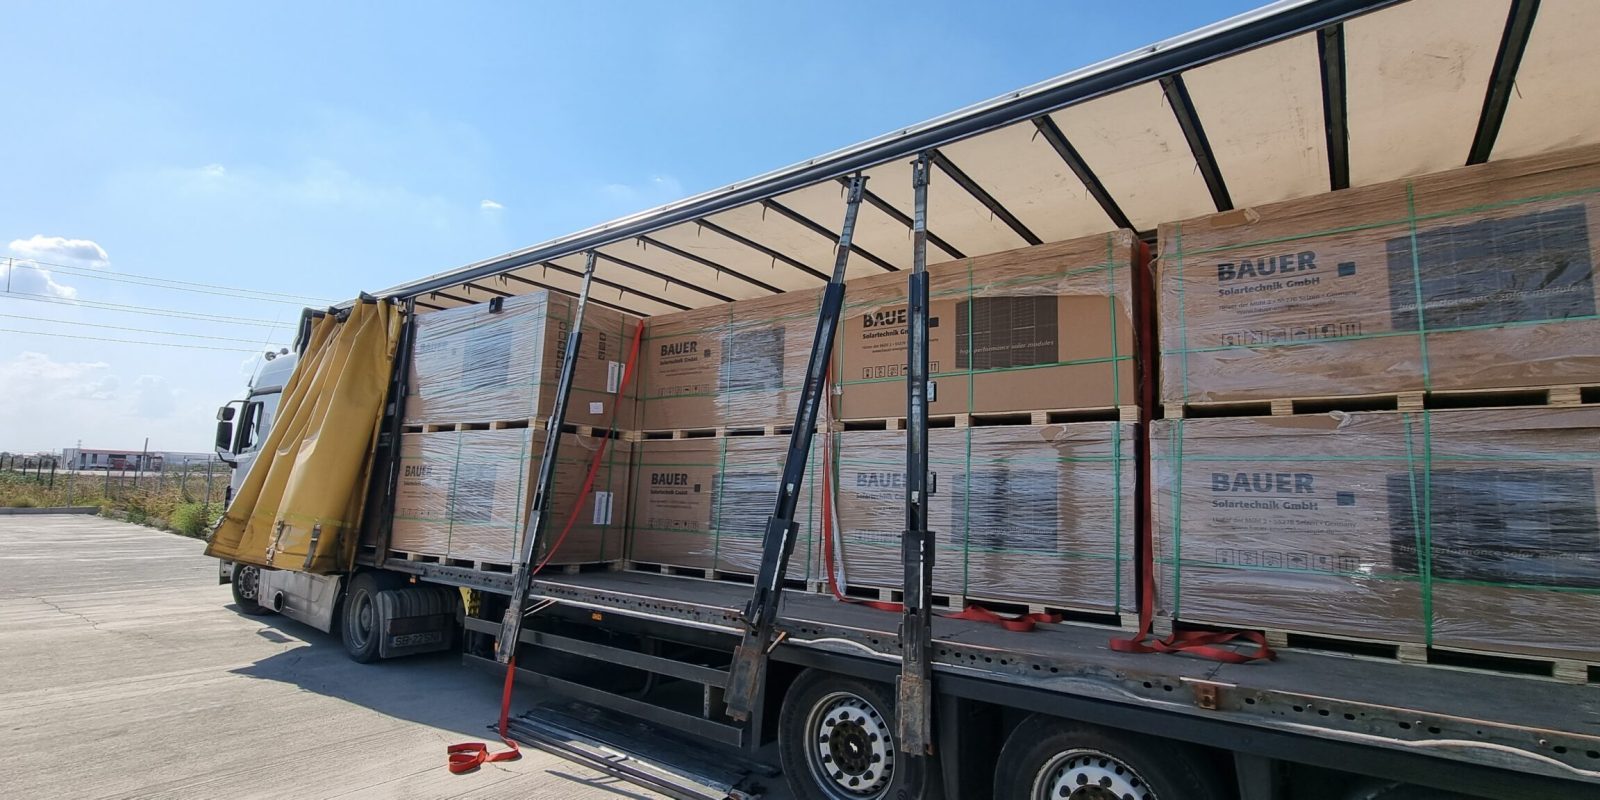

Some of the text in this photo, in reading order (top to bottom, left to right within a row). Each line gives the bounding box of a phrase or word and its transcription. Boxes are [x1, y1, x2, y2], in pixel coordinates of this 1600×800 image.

[1217, 250, 1317, 281] BAUER
[1218, 277, 1320, 297] Solartechnik GmbH
[863, 309, 907, 328] BAUE
[862, 329, 898, 339] Solartechnik
[661, 340, 697, 356] BAUER
[651, 473, 688, 486] BAUER
[856, 472, 907, 488] BAUE
[1212, 472, 1315, 493] BAUER
[1212, 500, 1319, 510] Solartechnik GmbH
